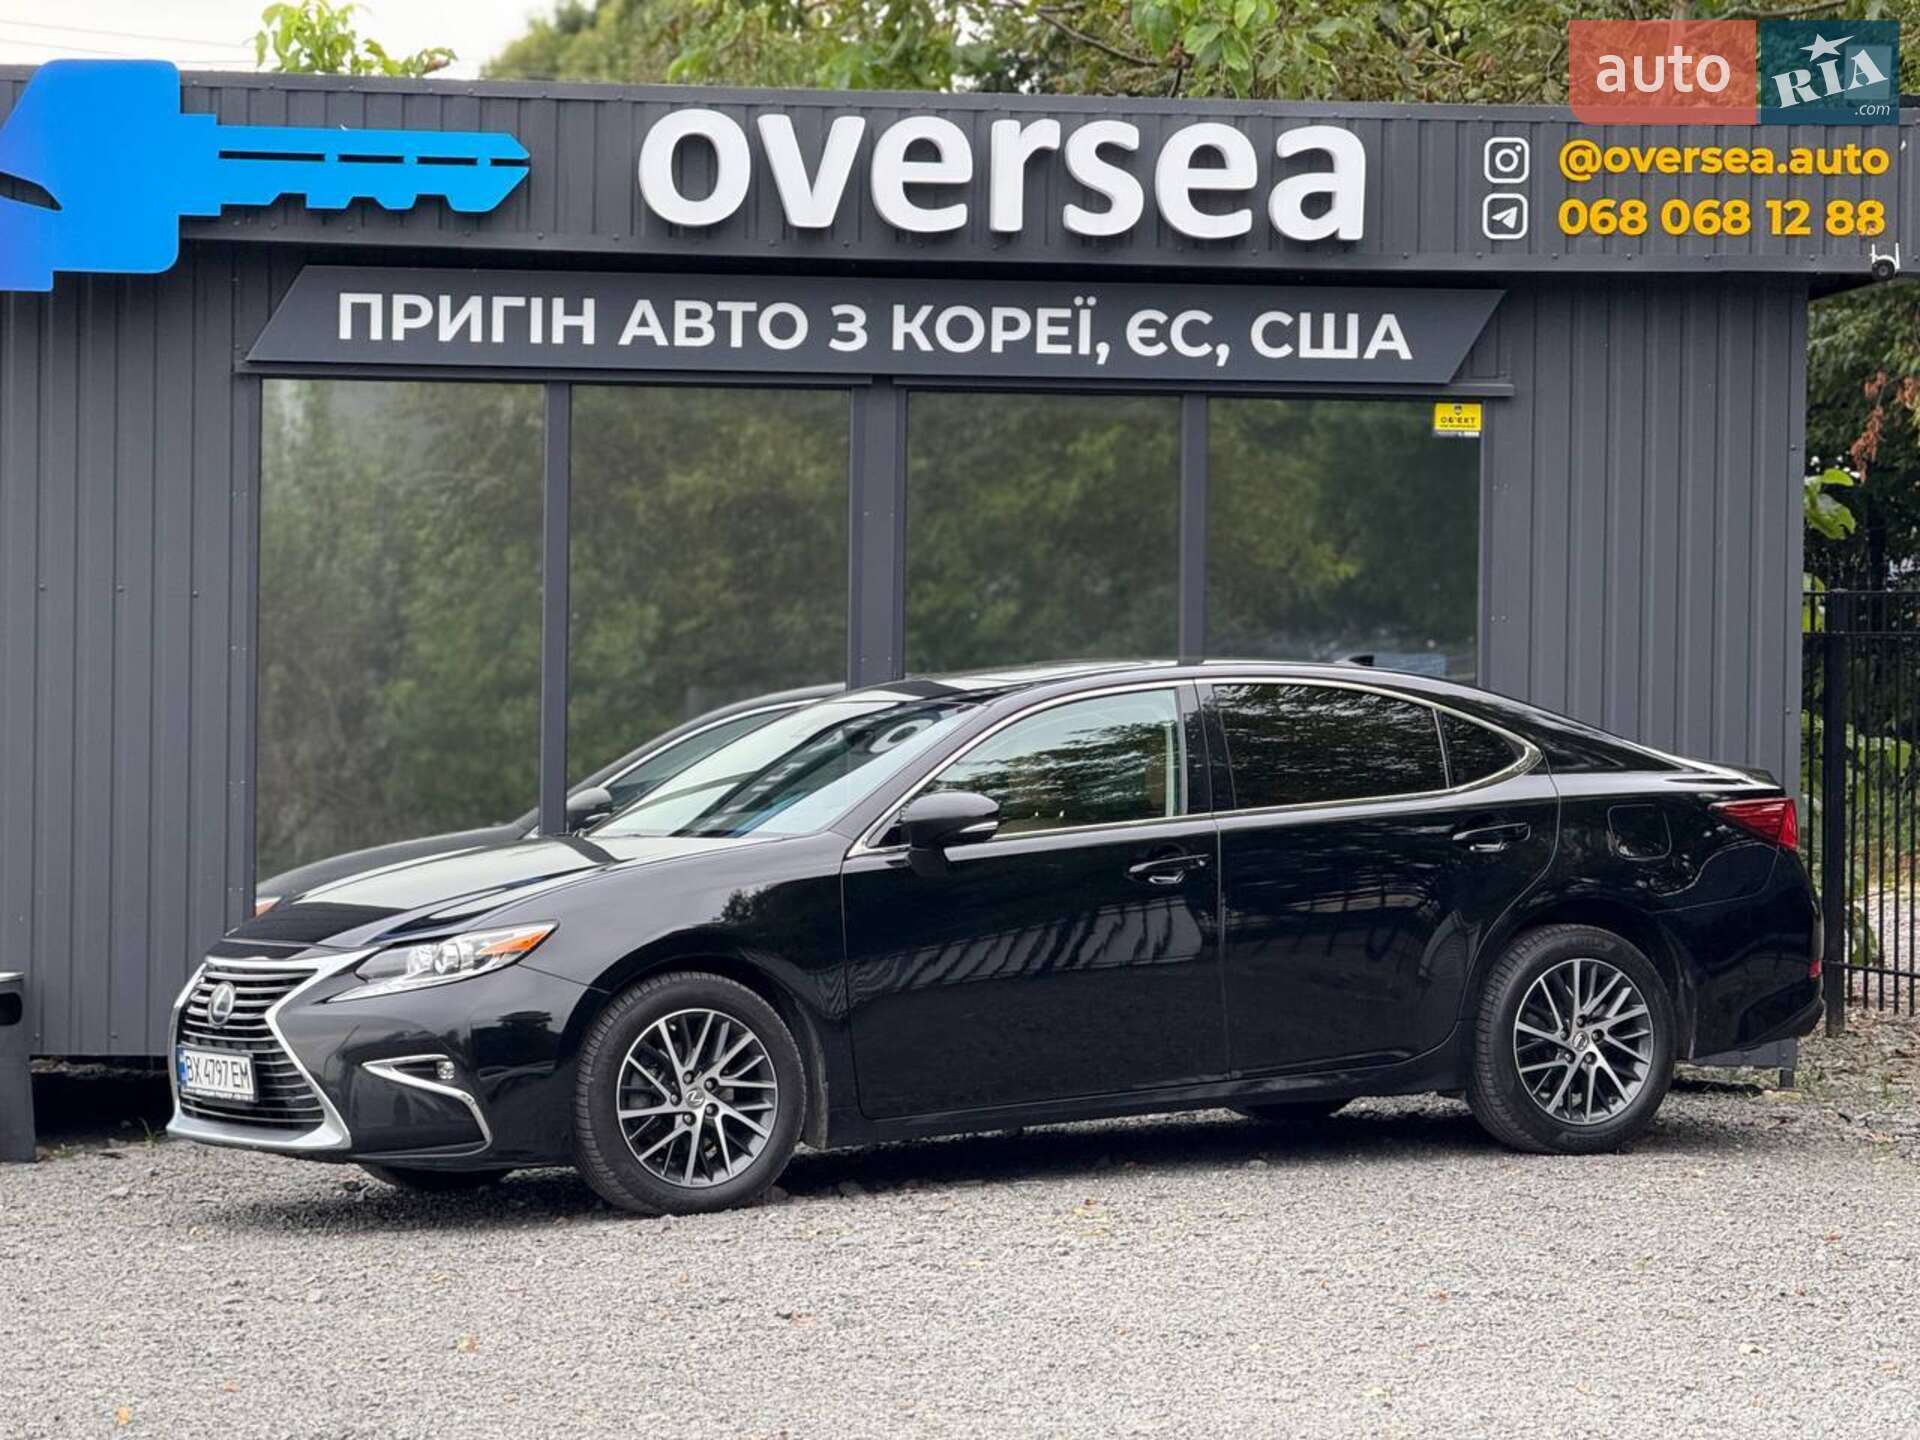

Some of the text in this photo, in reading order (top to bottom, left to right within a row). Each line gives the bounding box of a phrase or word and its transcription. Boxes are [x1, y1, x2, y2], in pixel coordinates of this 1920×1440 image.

[638, 107, 1366, 242] oversea
[1559, 139, 1890, 182] @oversea.auto
[1558, 199, 1886, 236] 068 068 12 88
[338, 292, 595, 346] ПРИГІН
[618, 299, 809, 351] АВТО
[892, 295, 1109, 366] КОРЕЇ,
[1125, 308, 1230, 367] ЄС,
[1250, 308, 1413, 361] США
